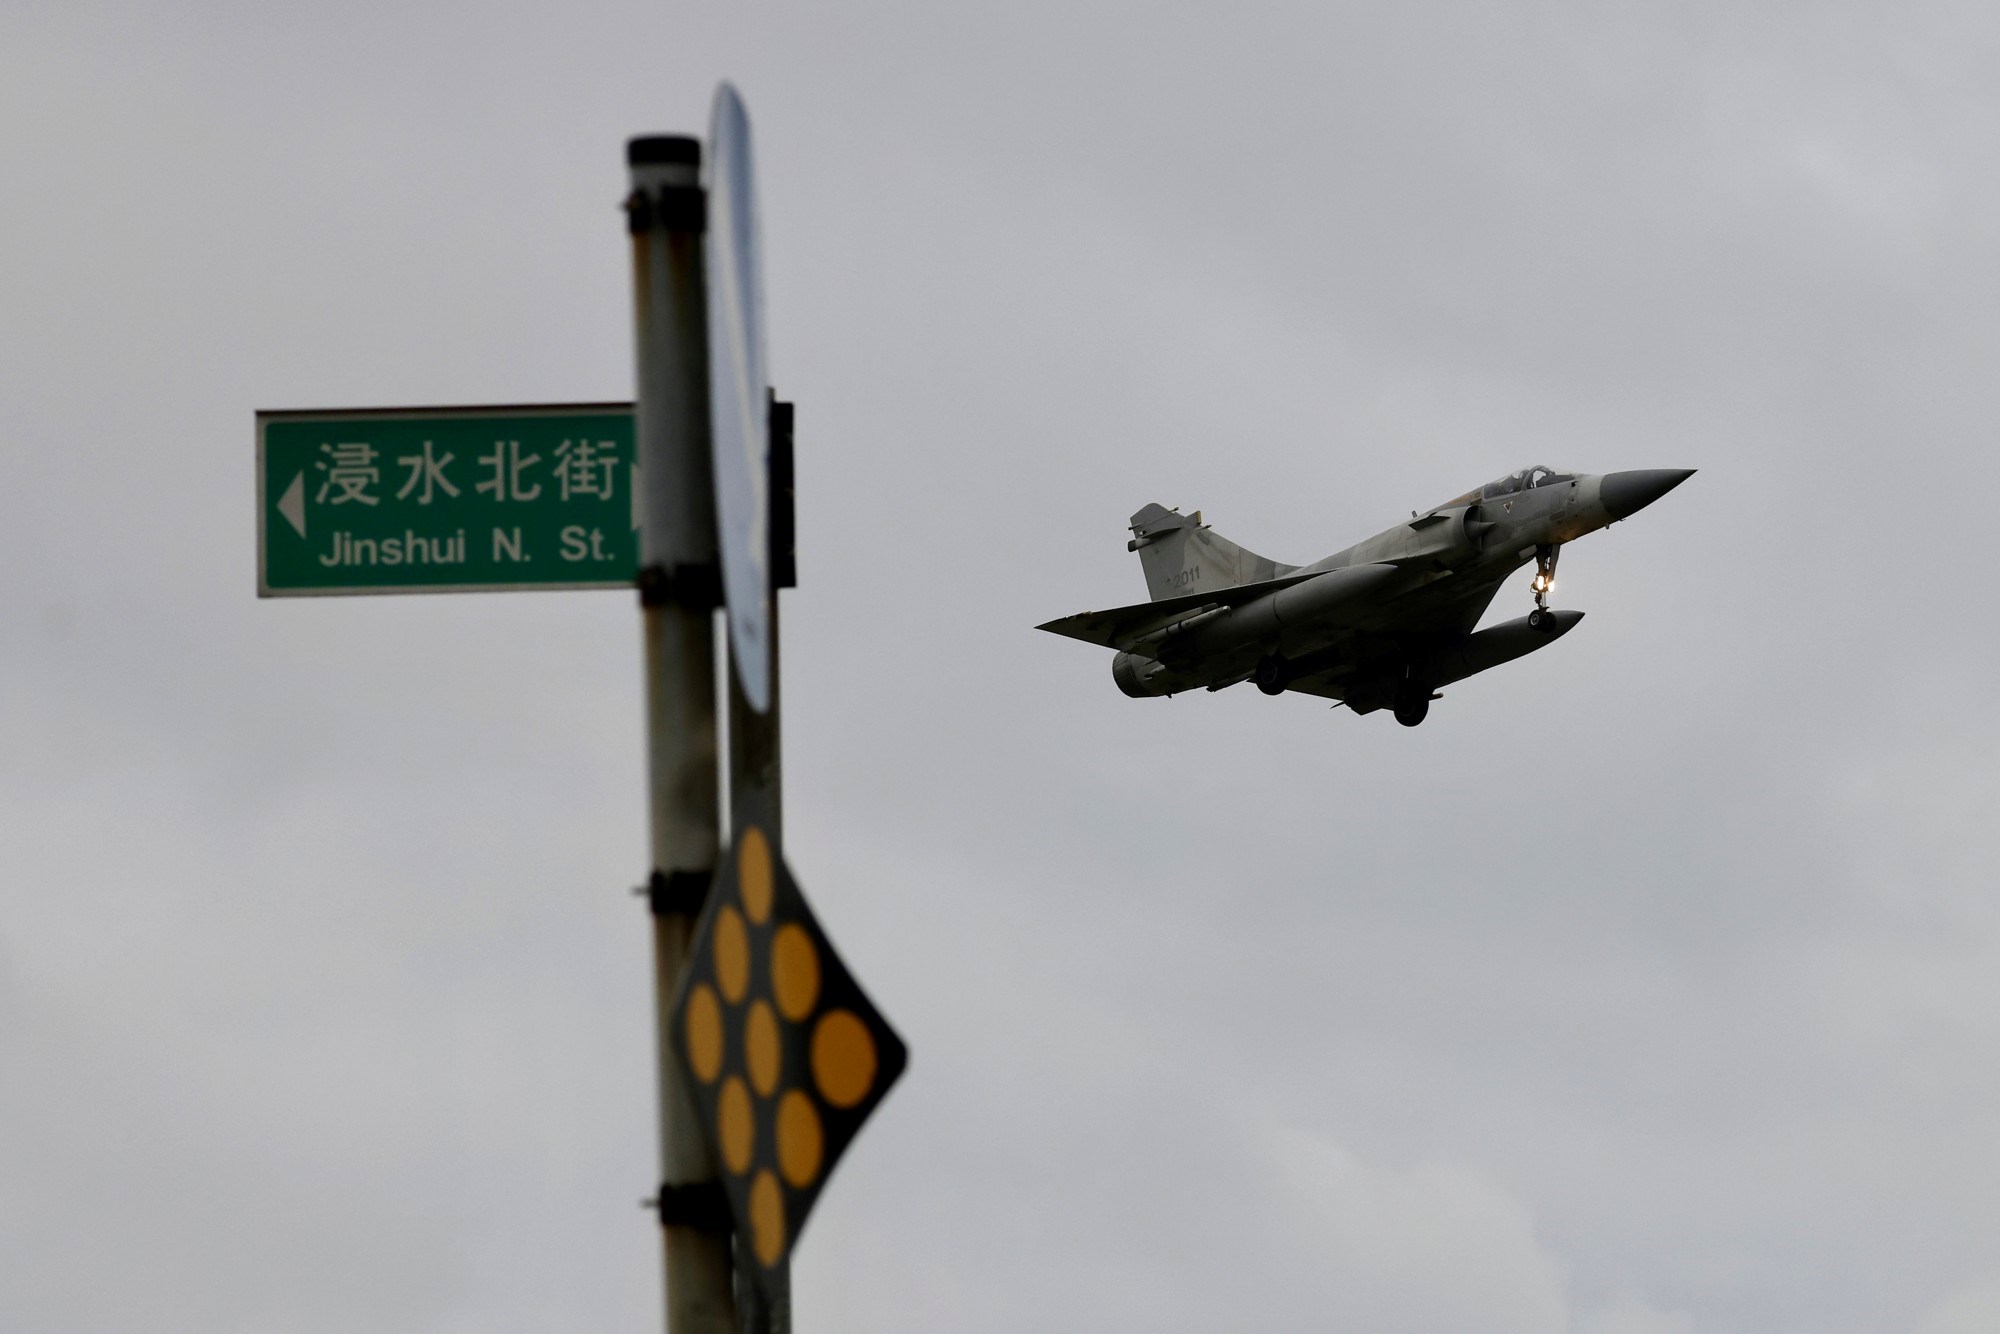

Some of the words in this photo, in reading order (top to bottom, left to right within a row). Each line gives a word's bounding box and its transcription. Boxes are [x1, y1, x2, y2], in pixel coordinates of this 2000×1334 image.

[315, 439, 619, 506] 浸水北街
[319, 528, 465, 566] Jinshui
[493, 527, 531, 562] N.
[559, 525, 615, 561] St.
[1173, 565, 1200, 589] 2011
